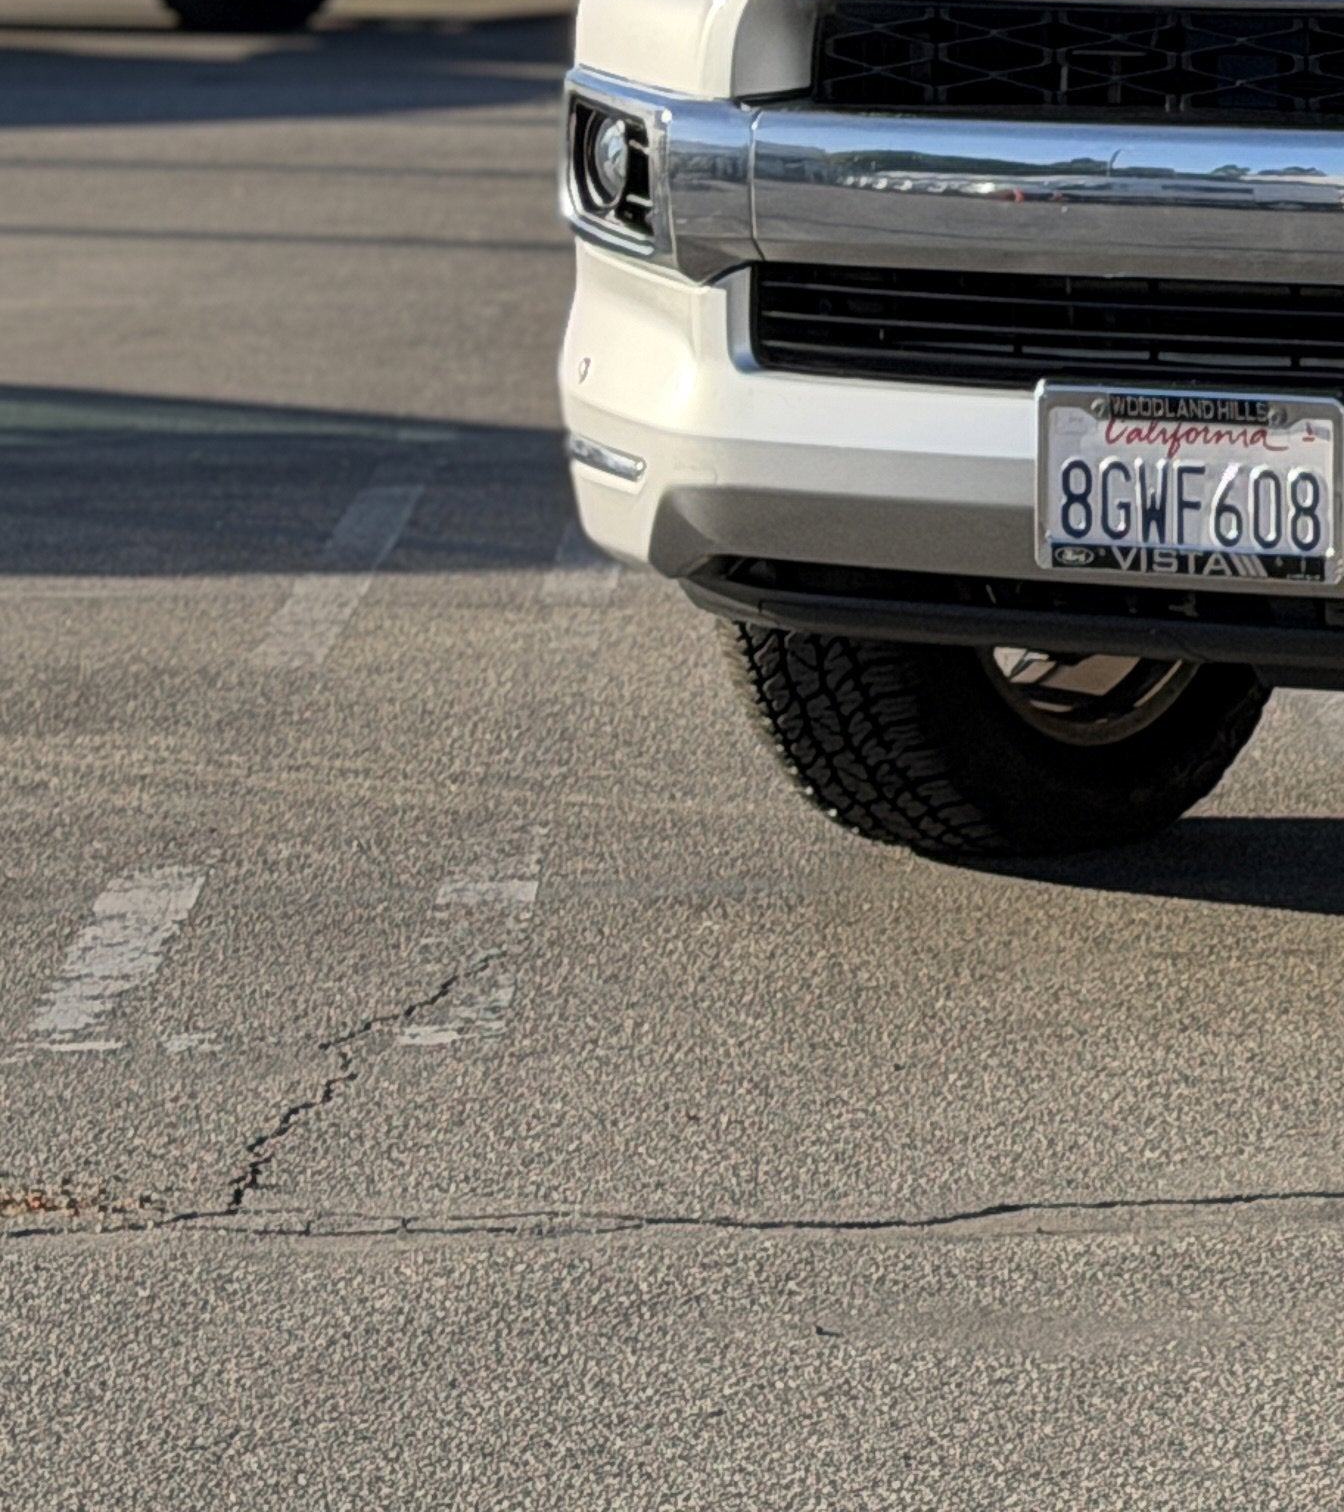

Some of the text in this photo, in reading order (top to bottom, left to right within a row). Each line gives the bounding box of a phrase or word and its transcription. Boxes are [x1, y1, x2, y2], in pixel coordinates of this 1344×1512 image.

[1112, 397, 1268, 422] WOODLAND HILLS
[1104, 419, 1289, 459] California
[1061, 457, 1322, 552] 8GWF608
[1112, 546, 1235, 577] VISTA
